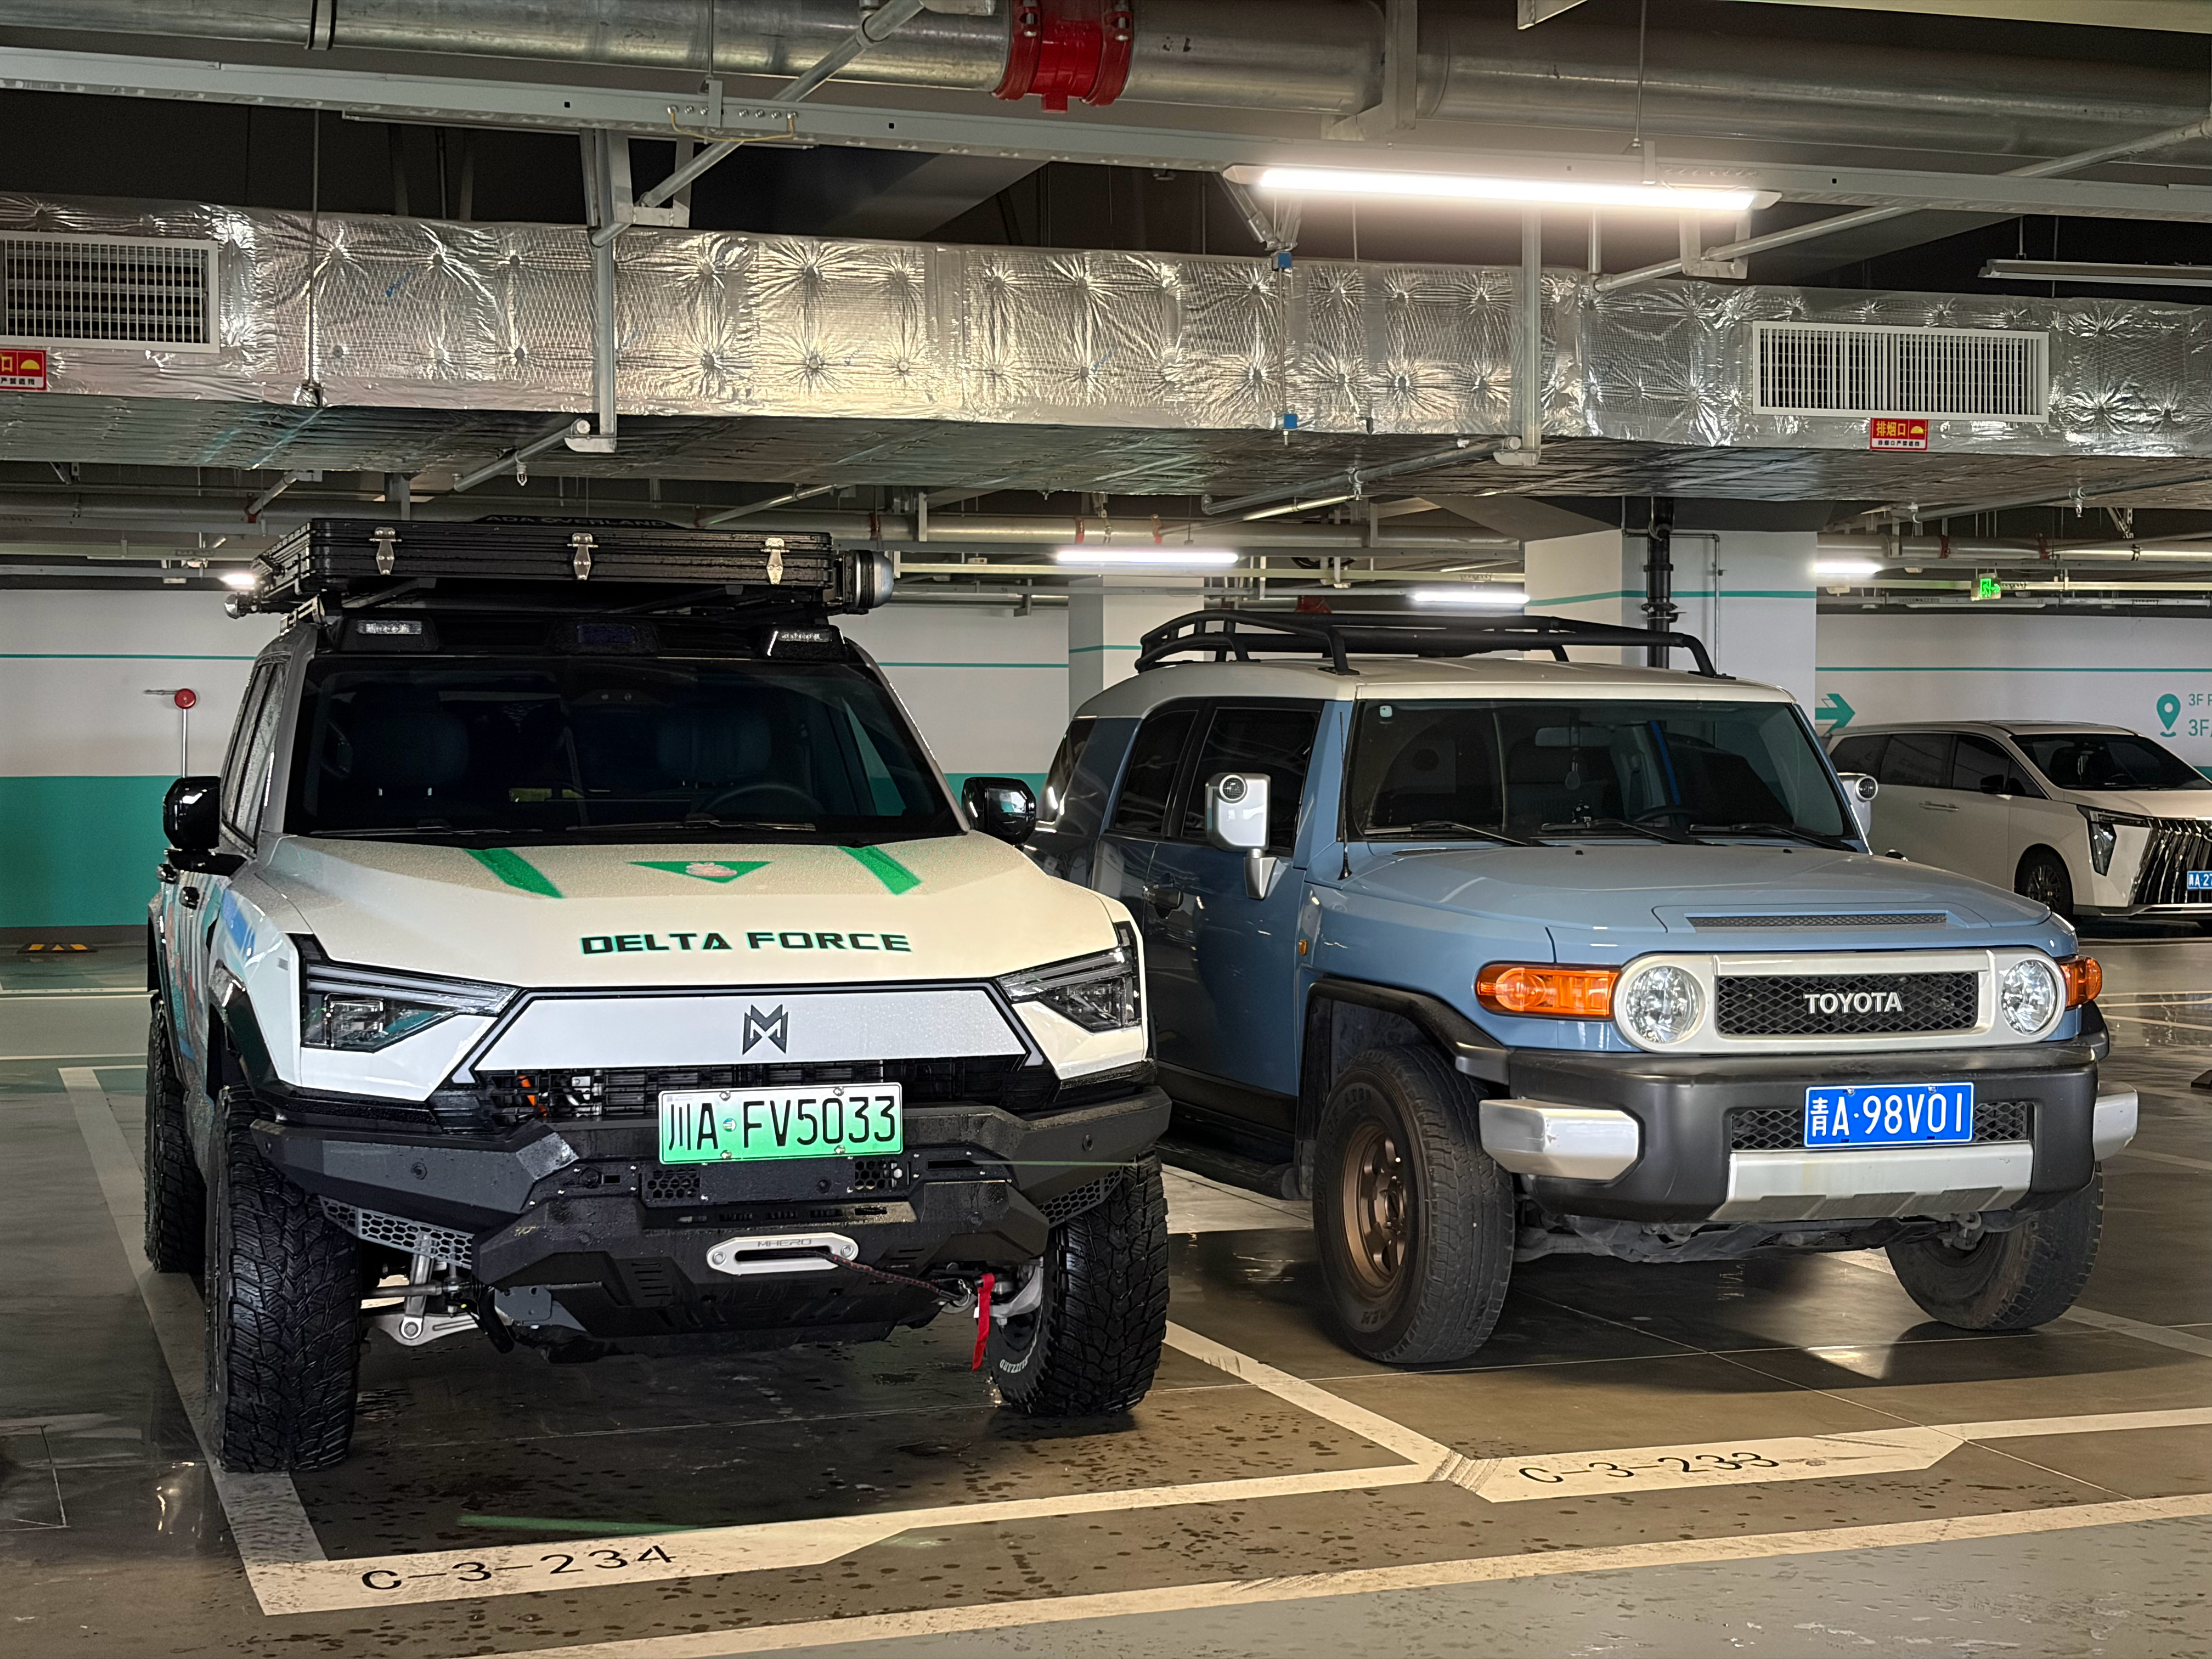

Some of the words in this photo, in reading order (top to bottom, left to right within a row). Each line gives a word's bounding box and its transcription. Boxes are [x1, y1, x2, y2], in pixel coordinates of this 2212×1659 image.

[1876, 421, 1906, 437] 排烟口
[541, 518, 666, 527] OVERLAND
[2188, 693, 2204, 706] 3F
[582, 933, 733, 955] DELTA
[746, 932, 912, 952] FORCE
[1804, 991, 1904, 1014] TOYOTA
[758, 1238, 812, 1247] MHERO
[1519, 1452, 1779, 1483] C-3-233
[362, 1545, 677, 1590] C-3-234
